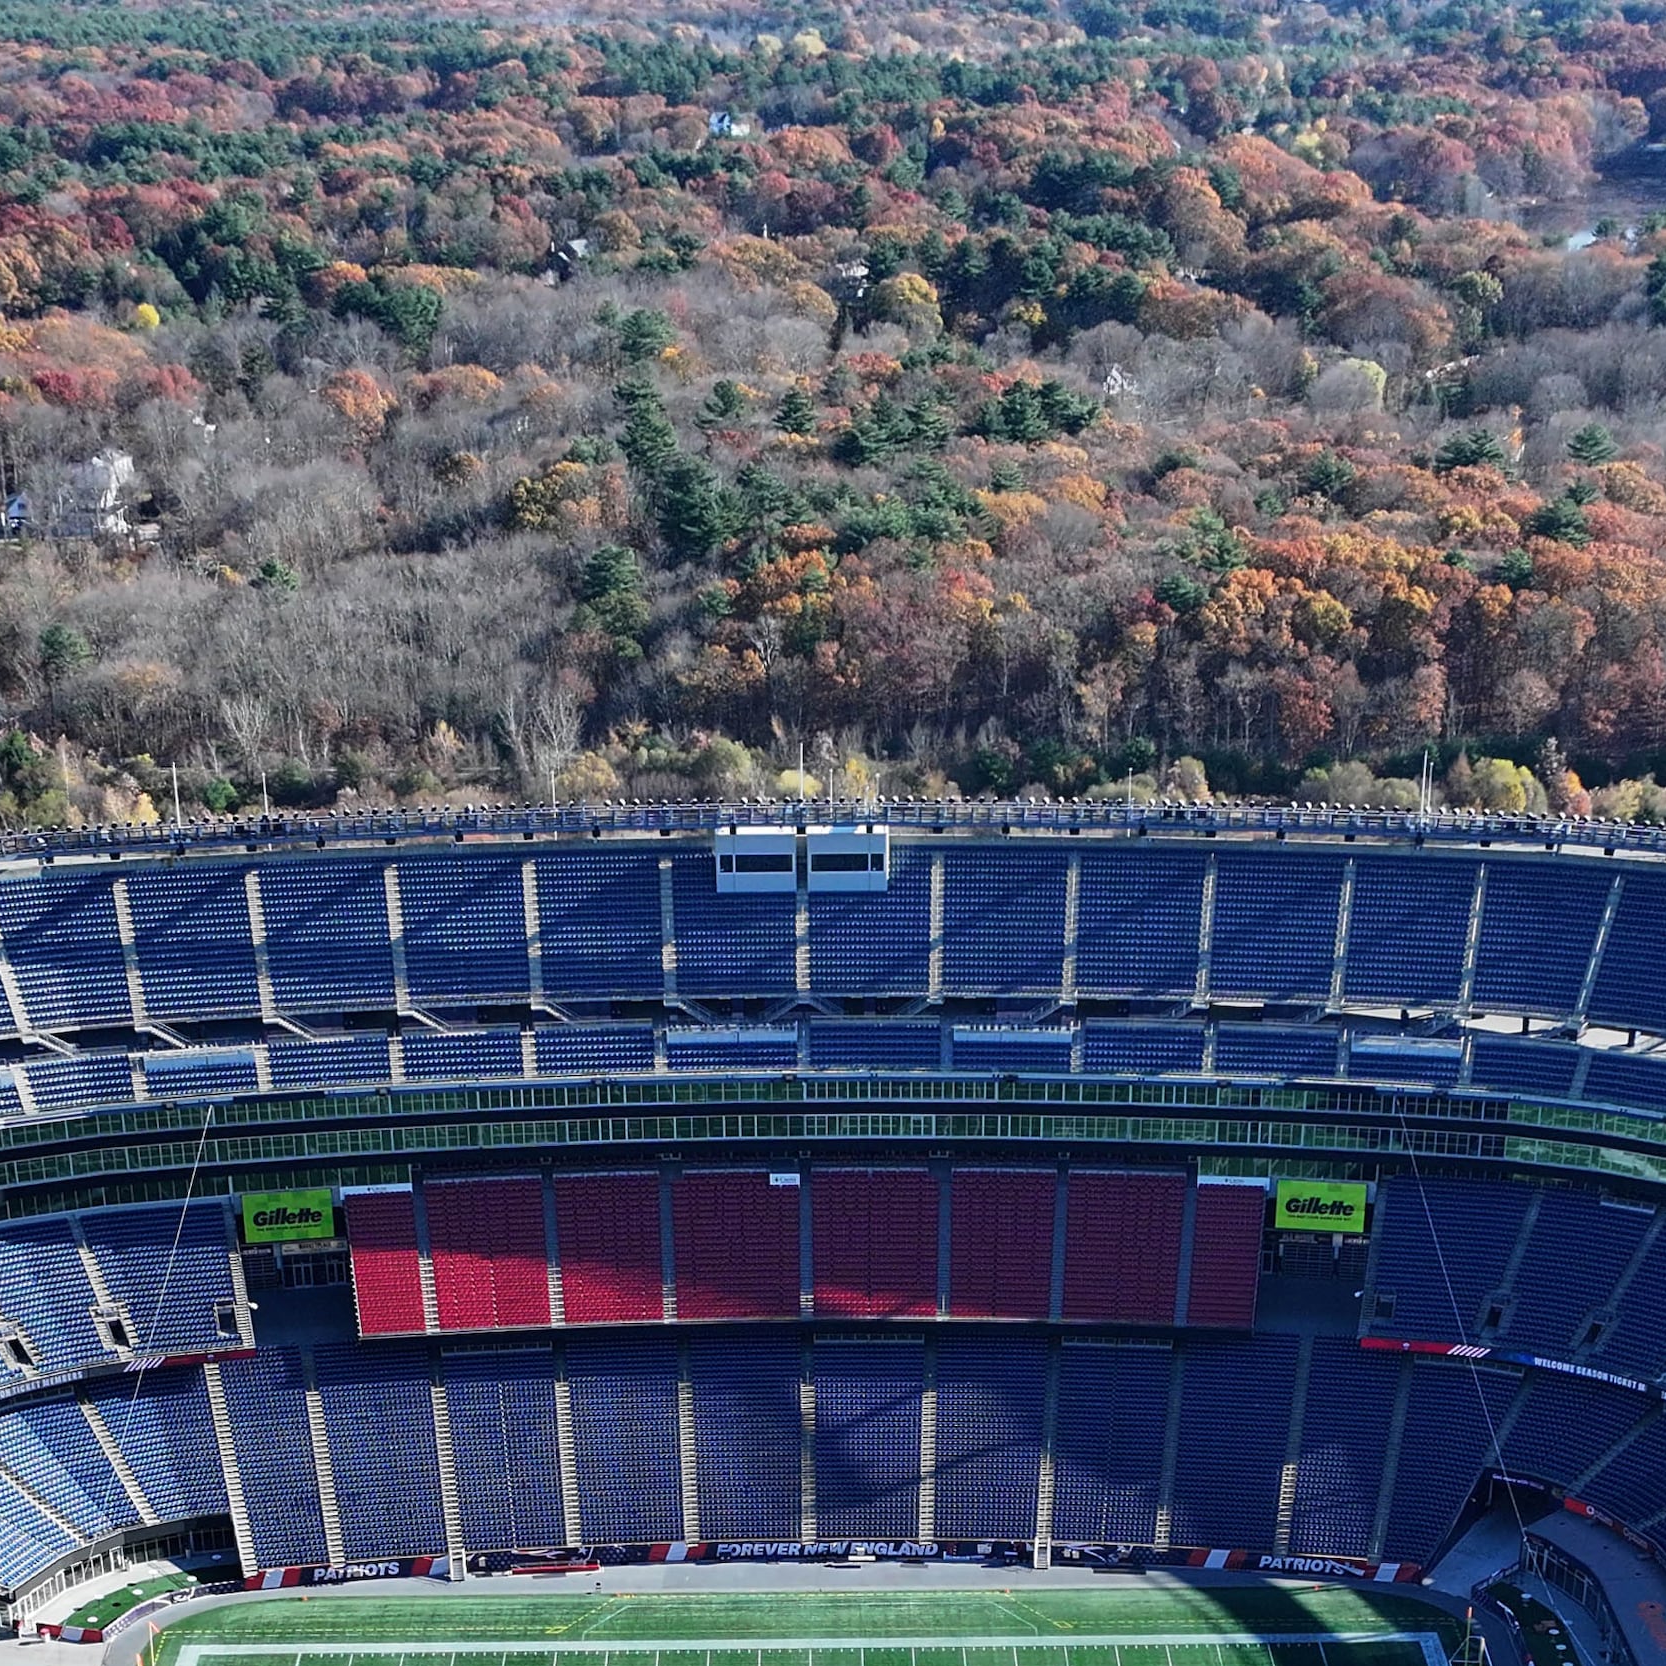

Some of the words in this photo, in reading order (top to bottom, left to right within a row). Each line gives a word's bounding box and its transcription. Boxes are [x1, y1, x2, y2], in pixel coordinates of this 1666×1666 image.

[1285, 1197, 1355, 1216] Gillette
[253, 1207, 323, 1227] Gillette
[1534, 1356, 1575, 1374] WELCOME
[1575, 1366, 1608, 1381] SEASON
[1609, 1374, 1637, 1390] TICKET
[716, 1542, 800, 1557] FOREVER
[802, 1540, 848, 1556] NEW
[849, 1540, 939, 1556] ENGLAND
[1259, 1554, 1344, 1576] PATRIOTS
